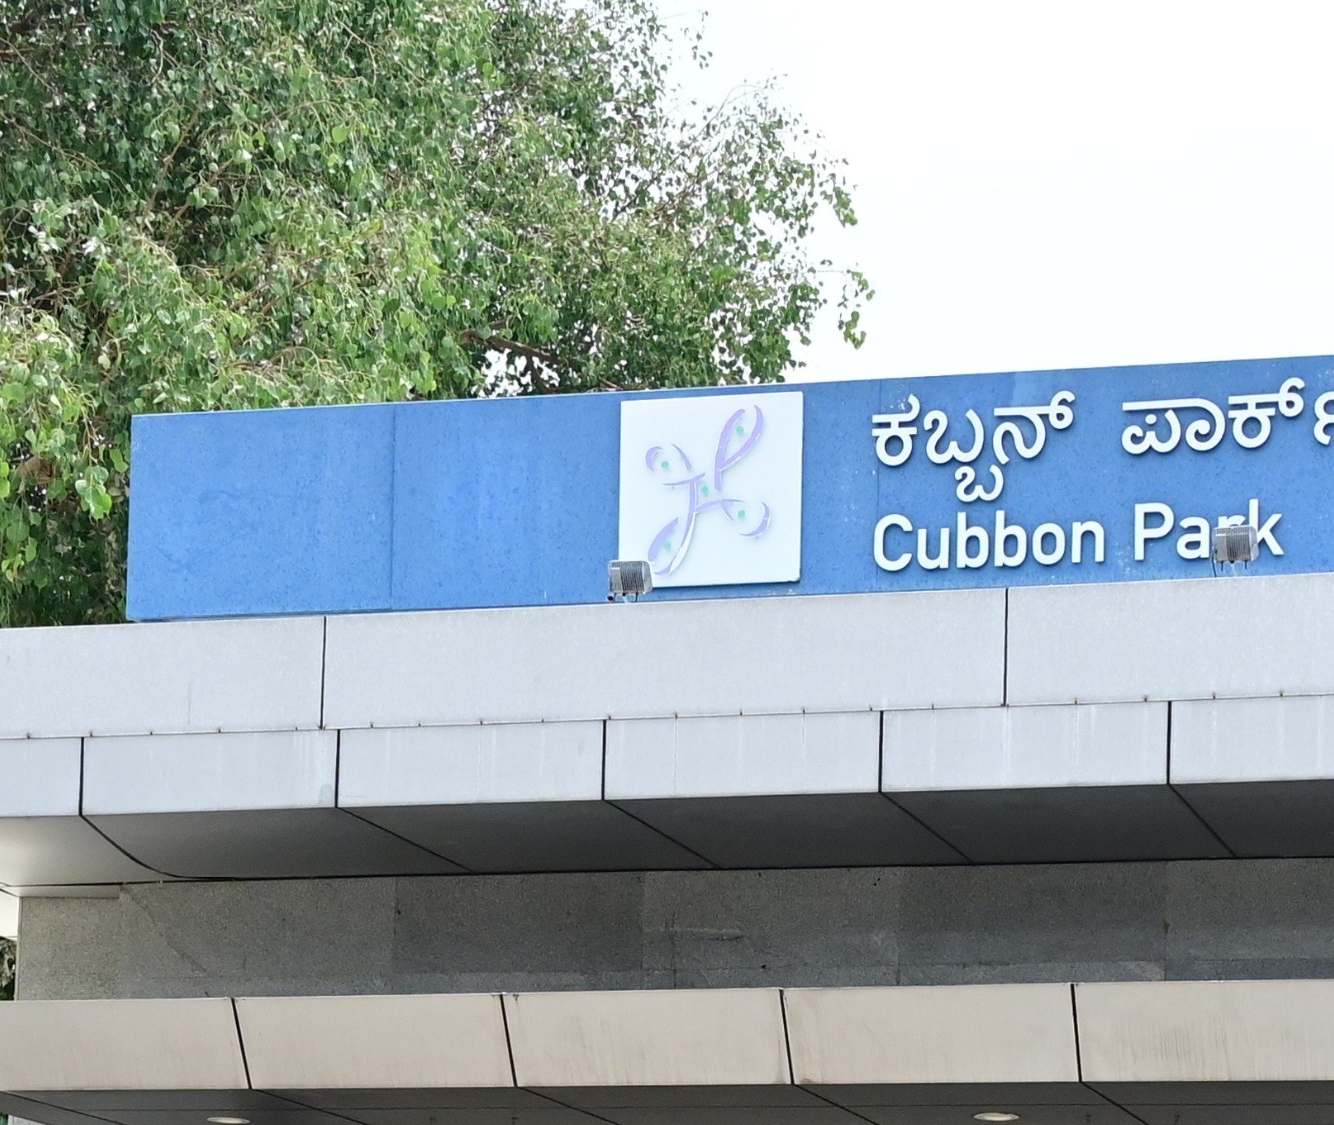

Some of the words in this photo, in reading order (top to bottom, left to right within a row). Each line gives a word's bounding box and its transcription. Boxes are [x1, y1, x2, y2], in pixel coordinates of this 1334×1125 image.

[871, 390, 1076, 502] ಕಬ್ಬನ್
[873, 510, 1105, 571] Cubbon
[1134, 499, 1285, 561] Pak
